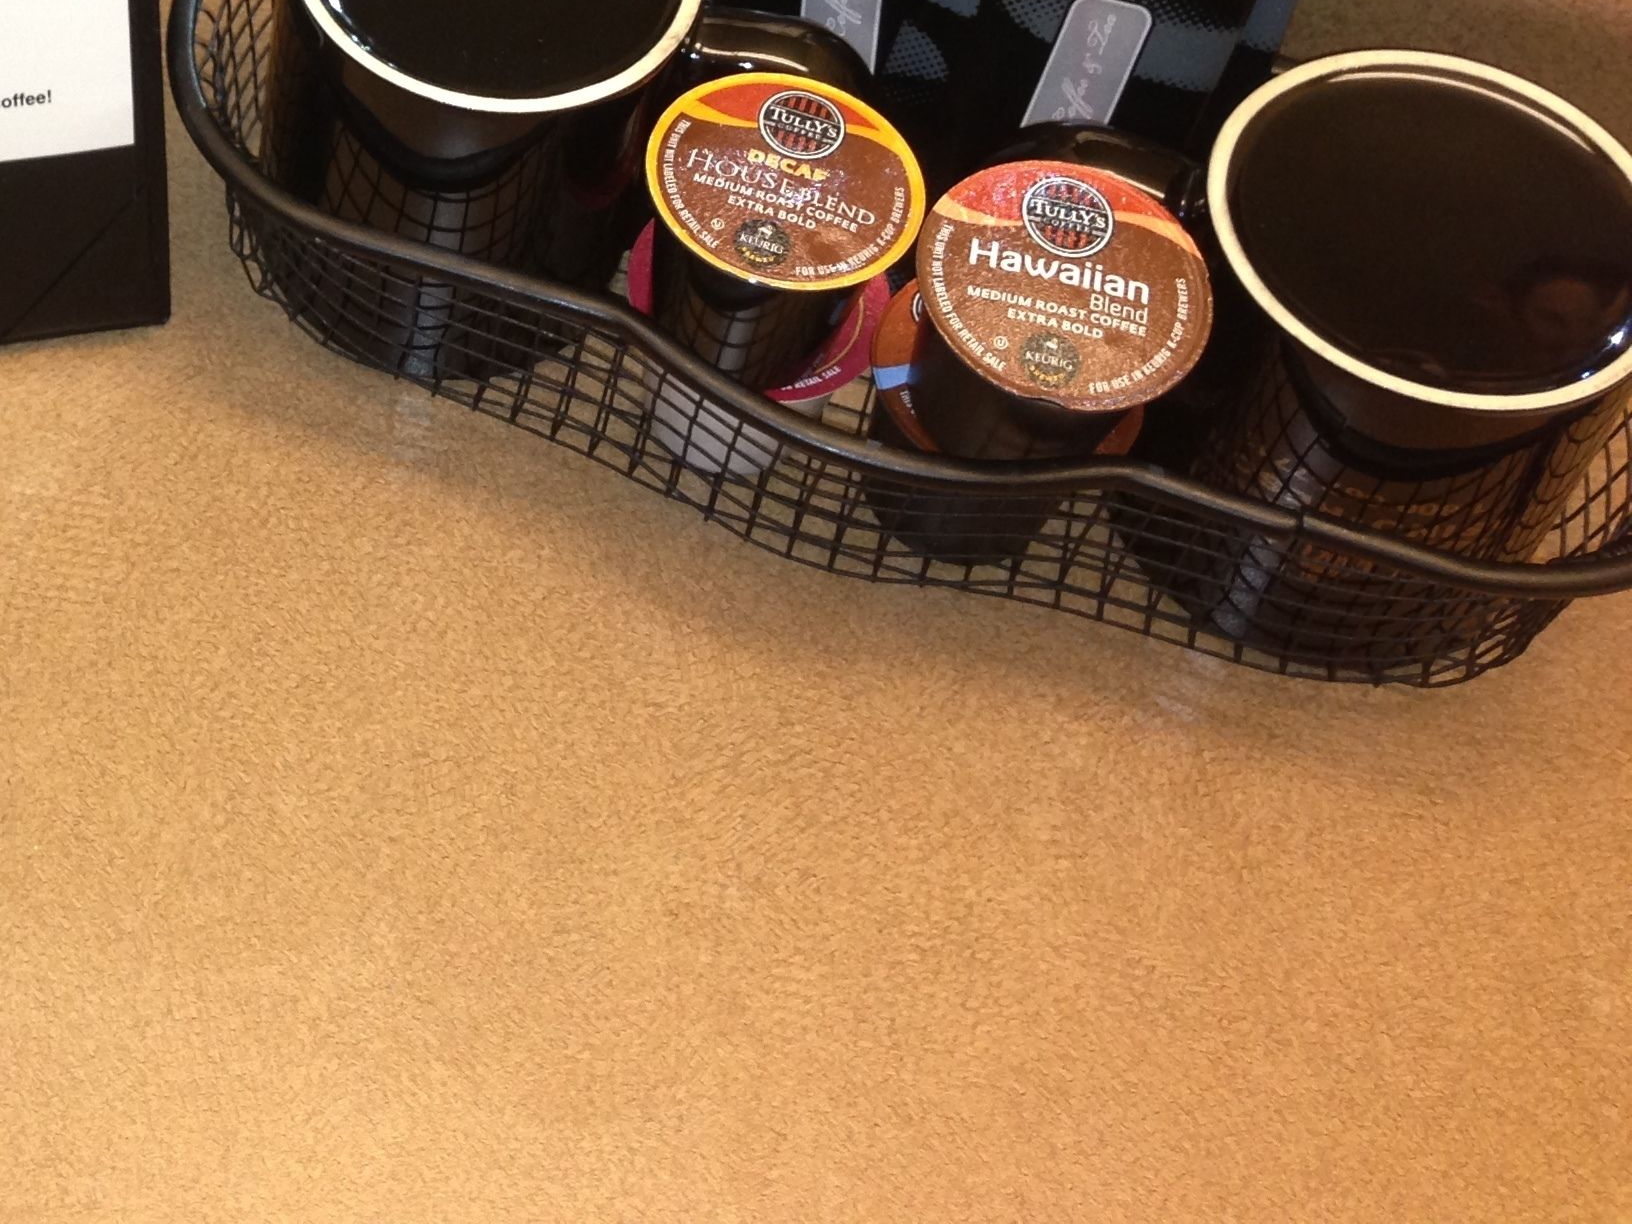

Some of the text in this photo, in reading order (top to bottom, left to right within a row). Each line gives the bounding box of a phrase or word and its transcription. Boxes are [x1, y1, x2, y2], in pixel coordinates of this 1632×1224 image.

[769, 106, 838, 138] TULLY'S
[748, 148, 829, 181] DECAF
[693, 173, 859, 233] MEDIUM ROAST COFFEE
[728, 195, 817, 230] EXTRA BOLD
[1030, 198, 1106, 229] TULLY'S
[969, 237, 1149, 305] Hawaiian
[967, 285, 1147, 338] MEDIUM ROAST COFFEE
[1007, 308, 1104, 339] EXTRA BOLD
[1090, 293, 1149, 325] Blend
[983, 352, 1007, 372] SALE
[1089, 381, 1110, 394] FOR
